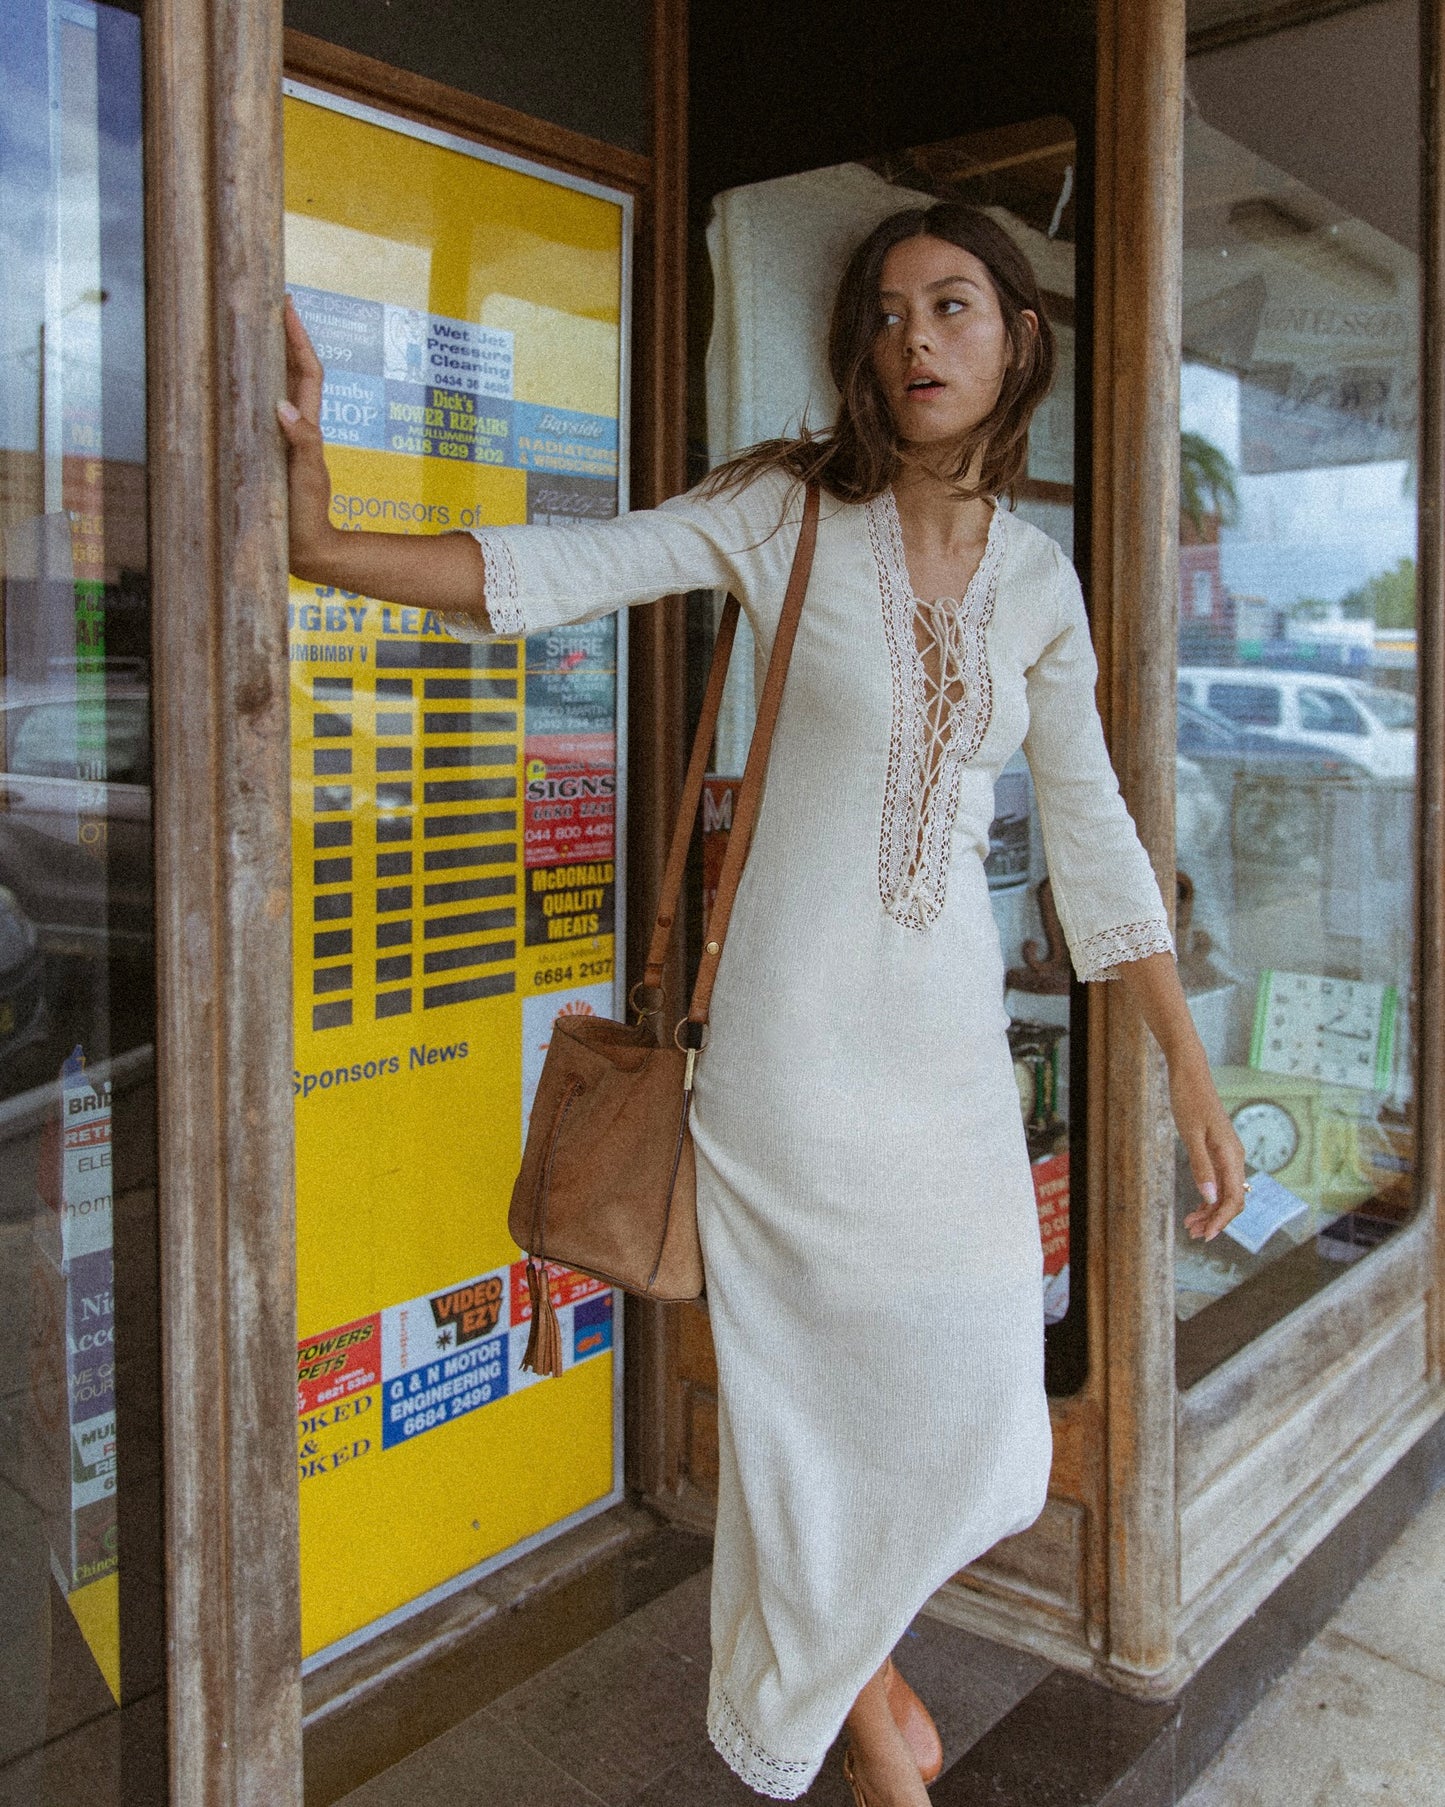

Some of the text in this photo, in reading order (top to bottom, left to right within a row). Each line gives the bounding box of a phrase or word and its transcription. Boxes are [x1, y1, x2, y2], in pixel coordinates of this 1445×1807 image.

[433, 324, 507, 348] Wet Jet
[317, 343, 353, 362] 3399
[427, 338, 512, 363] Pressure
[430, 354, 511, 380] Cleaning
[434, 373, 463, 387] 0434
[432, 389, 475, 413] Dick's
[388, 401, 510, 437] MOWER REPAIRS
[391, 435, 505, 463] 0418 629 202
[332, 494, 482, 527] sponsors of
[382, 609, 452, 636] LEA
[360, 646, 368, 662] V
[526, 775, 617, 802] SIGNS
[532, 863, 614, 892] McDONALD
[542, 889, 604, 917] QUALITY
[547, 914, 599, 940] MEATS
[534, 959, 613, 986] 6684 2137
[292, 1041, 469, 1097] Sponsors News
[433, 1277, 503, 1320] VIDEO
[462, 1301, 501, 1335] EZY
[390, 1380, 404, 1400] G
[409, 1372, 423, 1393] &
[427, 1365, 441, 1385] N
[444, 1340, 501, 1378] MOTOR
[390, 1360, 501, 1422] ENGINEERING
[403, 1384, 493, 1437] 6684 2499
[300, 1440, 319, 1458] &
